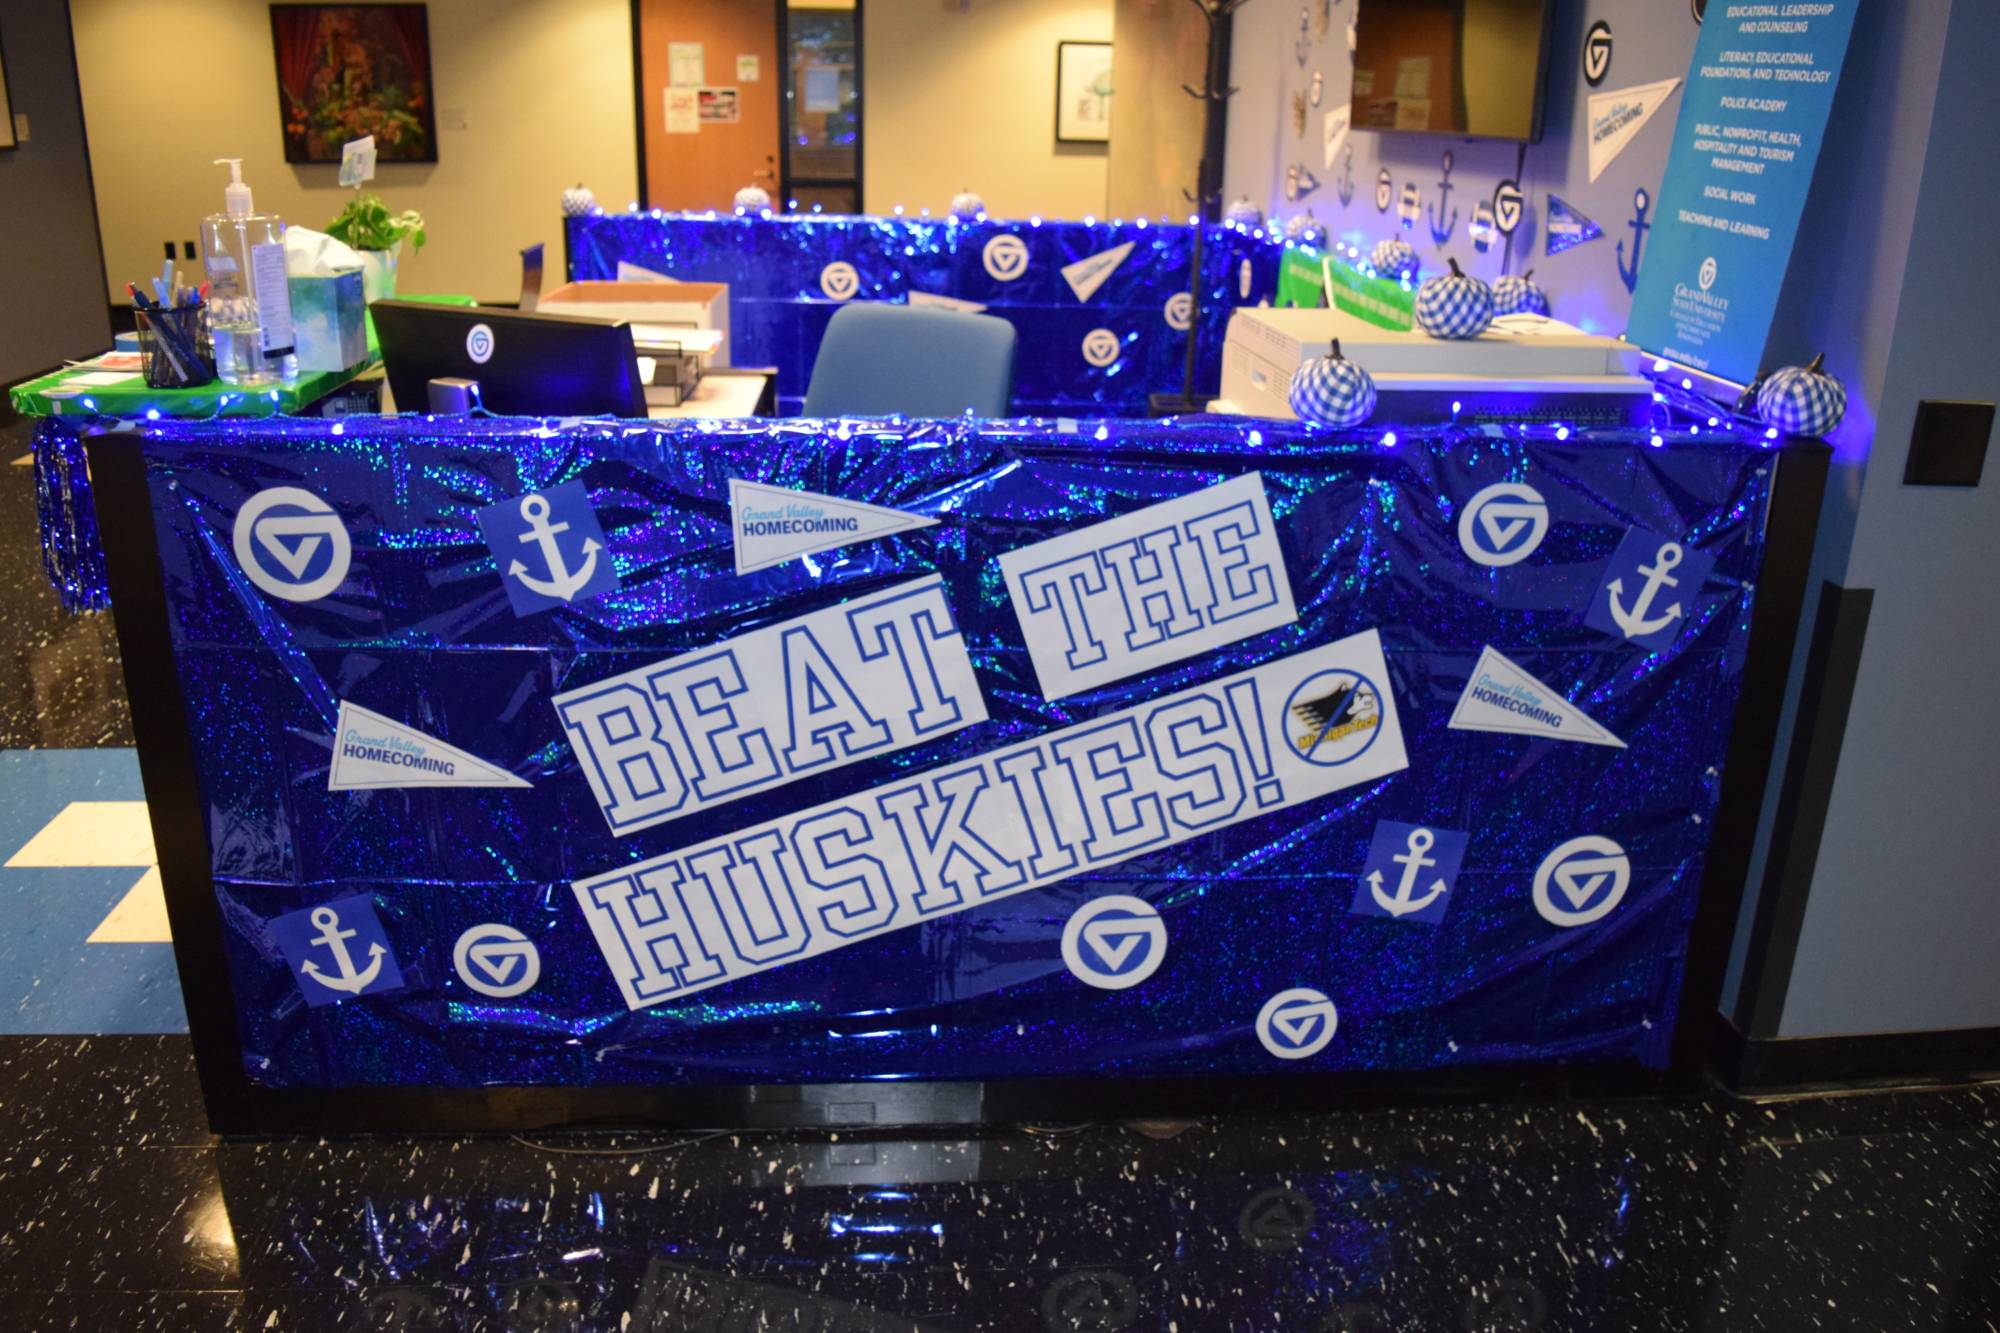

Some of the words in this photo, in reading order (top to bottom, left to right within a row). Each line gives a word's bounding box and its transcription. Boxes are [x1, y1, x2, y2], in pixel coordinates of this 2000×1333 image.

[1727, 6, 1778, 17] EDUCATIONAL
[1781, 4, 1835, 16] LEADERSHIP
[1739, 22, 1756, 32] AND
[1757, 21, 1808, 33] COUNSELING
[1756, 52, 1814, 65] EDUCATIONAL
[1753, 69, 1772, 79] AND
[1774, 70, 1831, 82] TECHNOLOGY
[1720, 97, 1746, 109] POLICE
[1747, 98, 1787, 112] ACADEMY
[1594, 102, 1643, 144] HOMECOMING
[1769, 132, 1801, 147] HEALTH,
[1694, 139, 1737, 154] HOSPITALITY
[1737, 144, 1757, 157] AND
[1759, 147, 1794, 162] TOURISM
[1711, 157, 1765, 175] MANAGEMENT
[1730, 190, 1757, 205] WORK
[1713, 218, 1728, 230] AND
[1730, 221, 1770, 240] LEARNING
[741, 506, 784, 521] Grand
[786, 504, 824, 521] Valley
[743, 518, 859, 537] HOMECOMING
[1019, 499, 1280, 672] THE
[1478, 673, 1512, 694] Grand
[555, 582, 961, 829] BEAT
[1471, 686, 1563, 729] HOMECOMING
[344, 729, 387, 748] Grand
[388, 736, 426, 757] Valley
[343, 743, 455, 776] HOMECOMING
[592, 678, 1284, 1002] HUSKIES!
